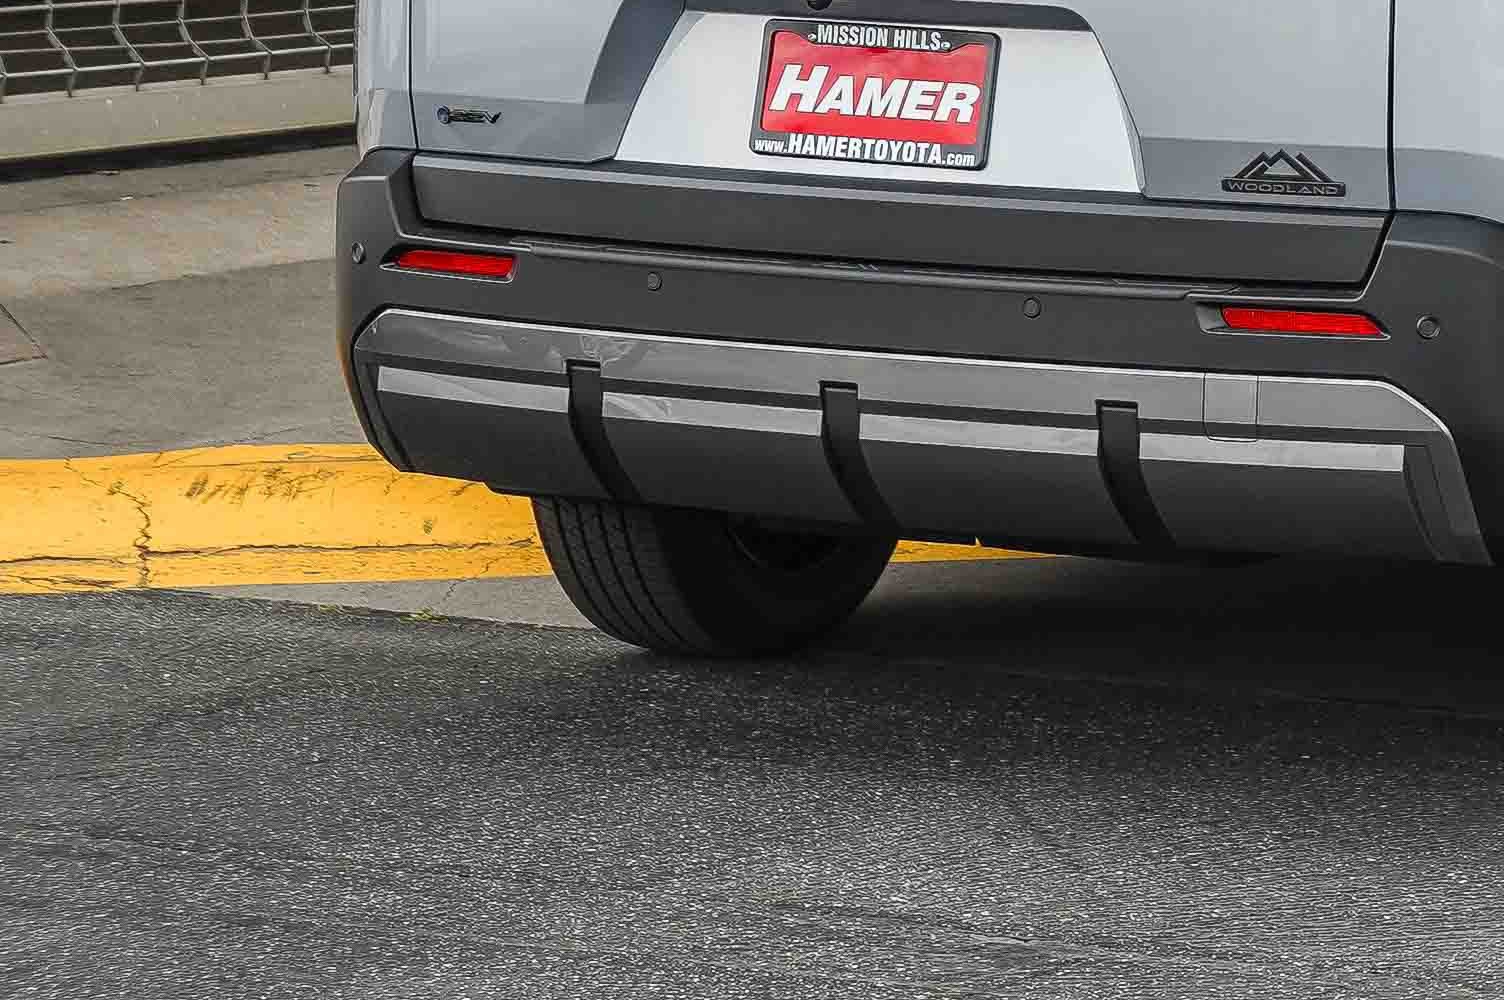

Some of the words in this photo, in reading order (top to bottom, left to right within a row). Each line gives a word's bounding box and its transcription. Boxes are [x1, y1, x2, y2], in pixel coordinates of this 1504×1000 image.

[817, 24, 890, 48] MISSION
[893, 29, 943, 51] HILLS
[768, 63, 981, 125] HAMER
[754, 133, 976, 168] www.HAMERTOYOTA.com
[1228, 182, 1338, 195] WOODLAND
